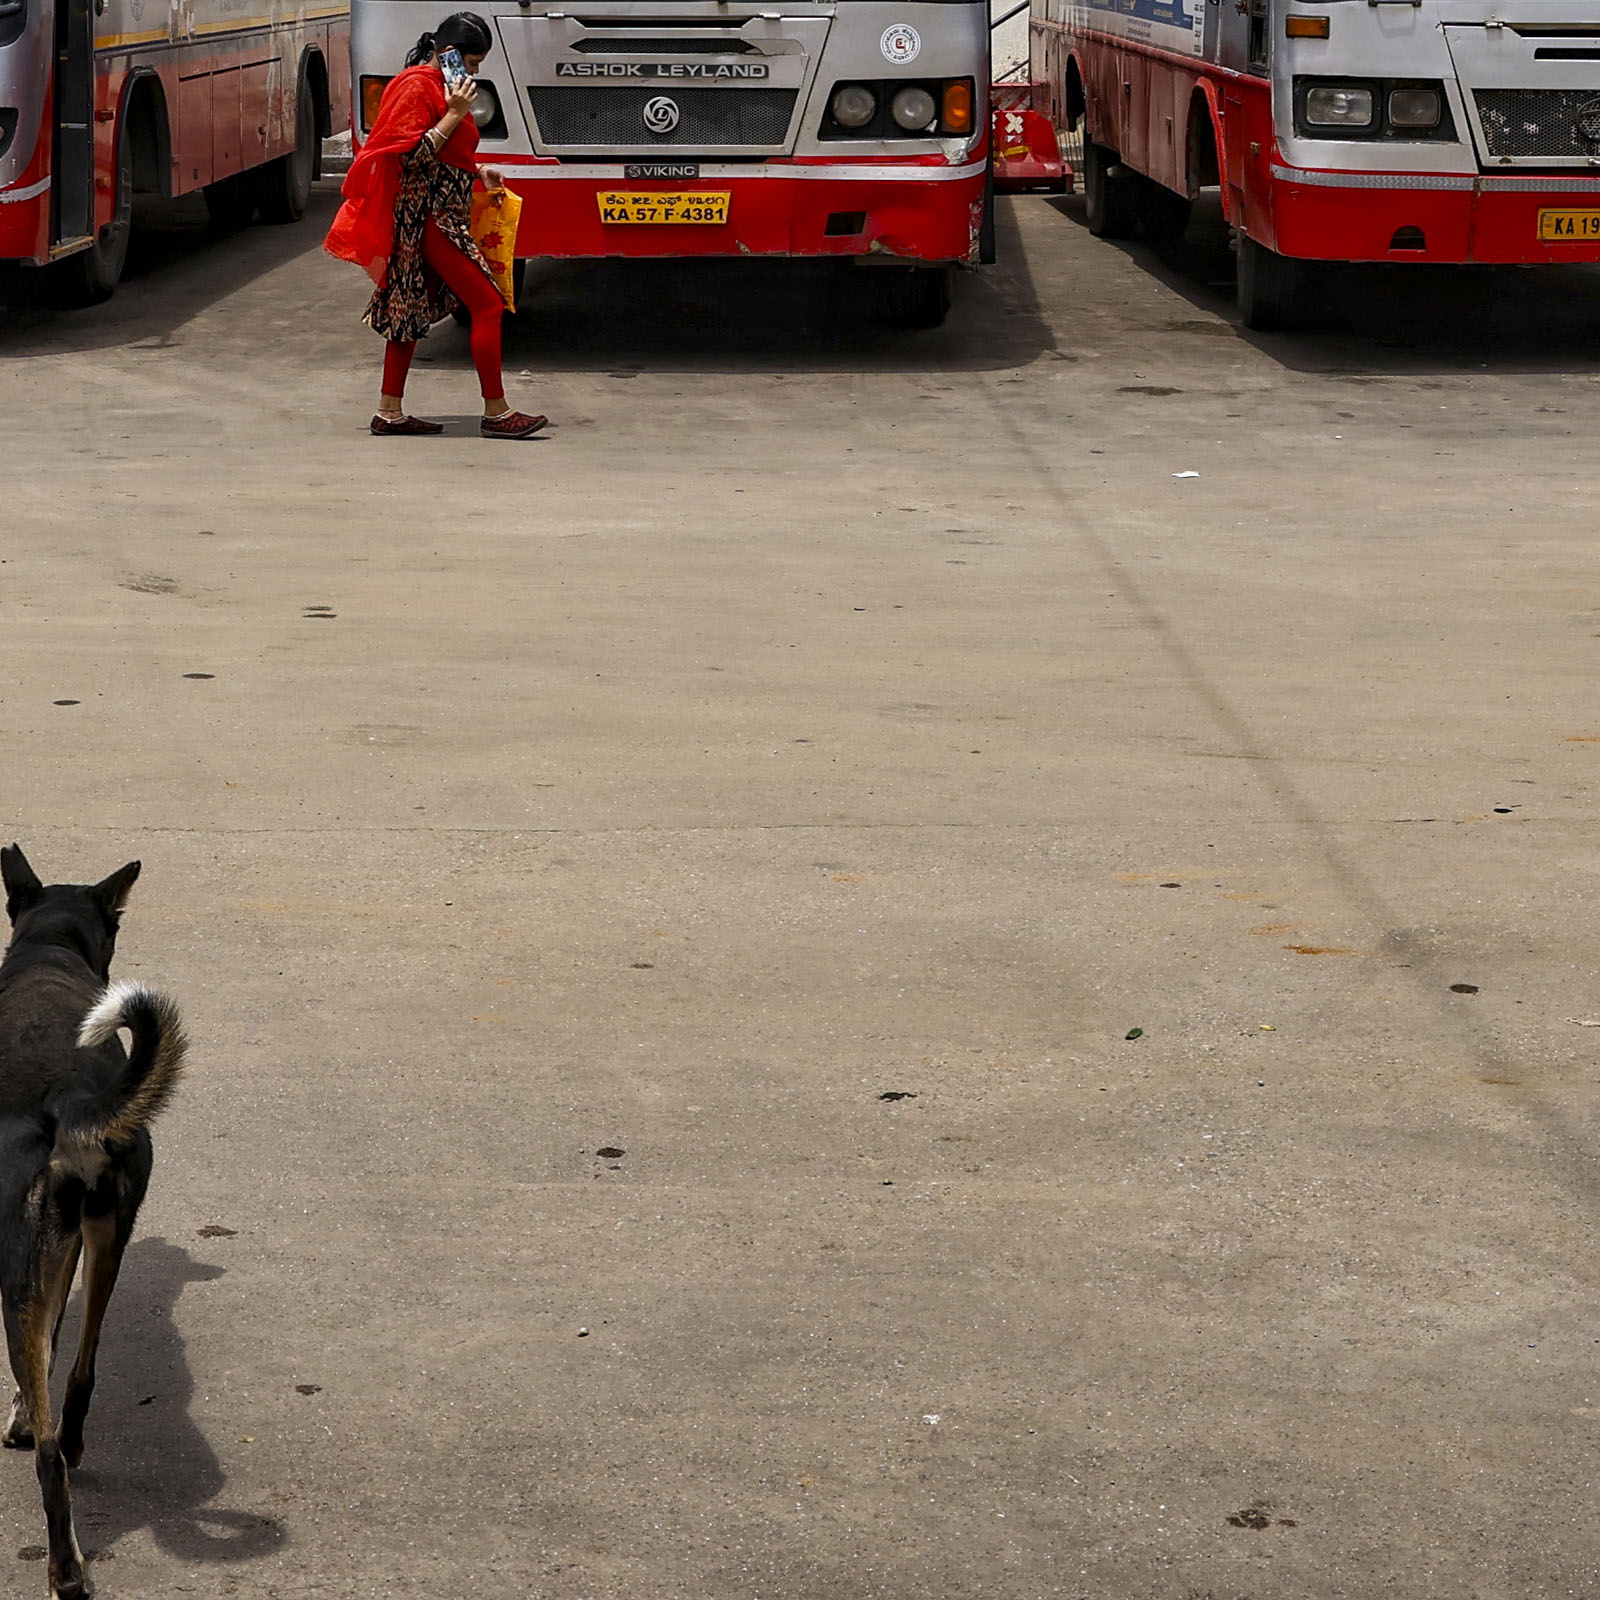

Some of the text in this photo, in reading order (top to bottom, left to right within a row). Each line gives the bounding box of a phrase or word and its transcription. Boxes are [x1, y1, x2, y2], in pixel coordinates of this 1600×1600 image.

[559, 64, 766, 78] ASHOK LEYLAND
[642, 165, 696, 177] VIKING
